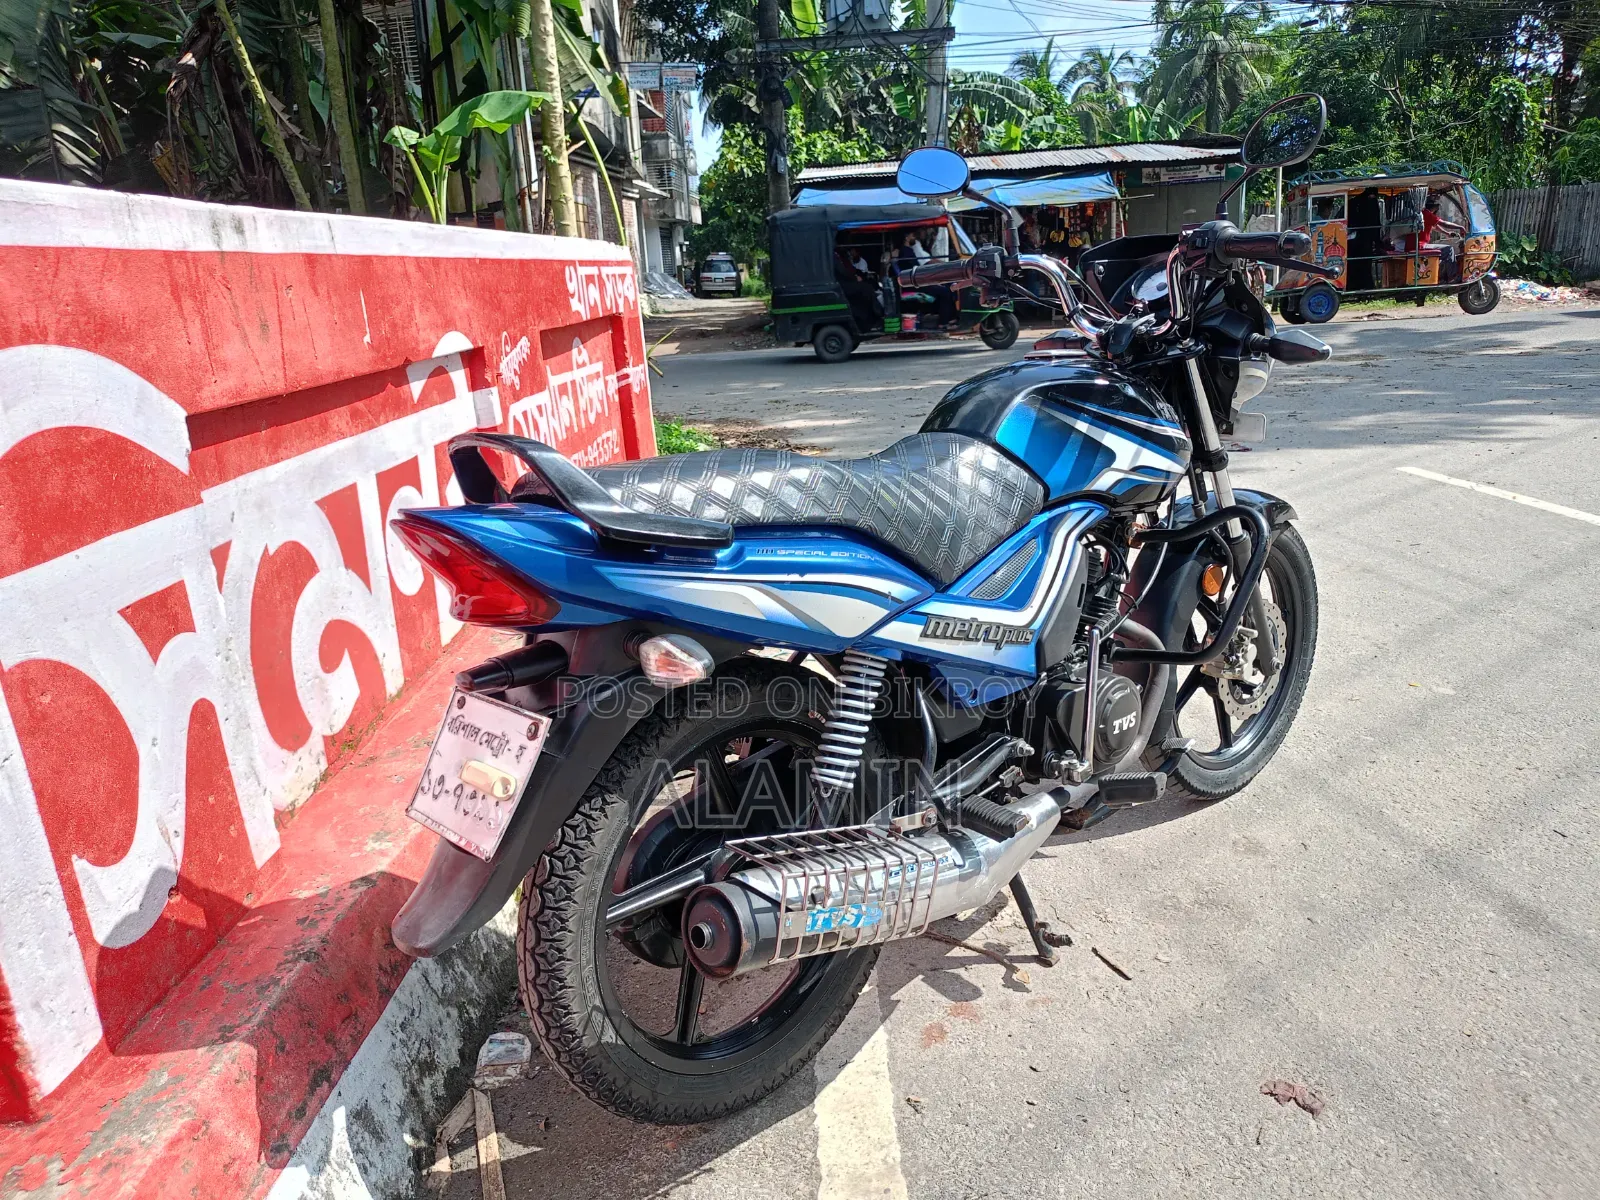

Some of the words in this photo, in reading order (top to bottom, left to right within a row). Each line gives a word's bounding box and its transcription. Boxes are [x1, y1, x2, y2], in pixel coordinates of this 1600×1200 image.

[565, 261, 602, 320] খান
[777, 549, 828, 557] SPECIAL
[831, 551, 875, 561] EDITION
[447, 714, 480, 743] বরিশাল
[1113, 711, 1137, 735] TVS
[814, 904, 861, 930] TVS
